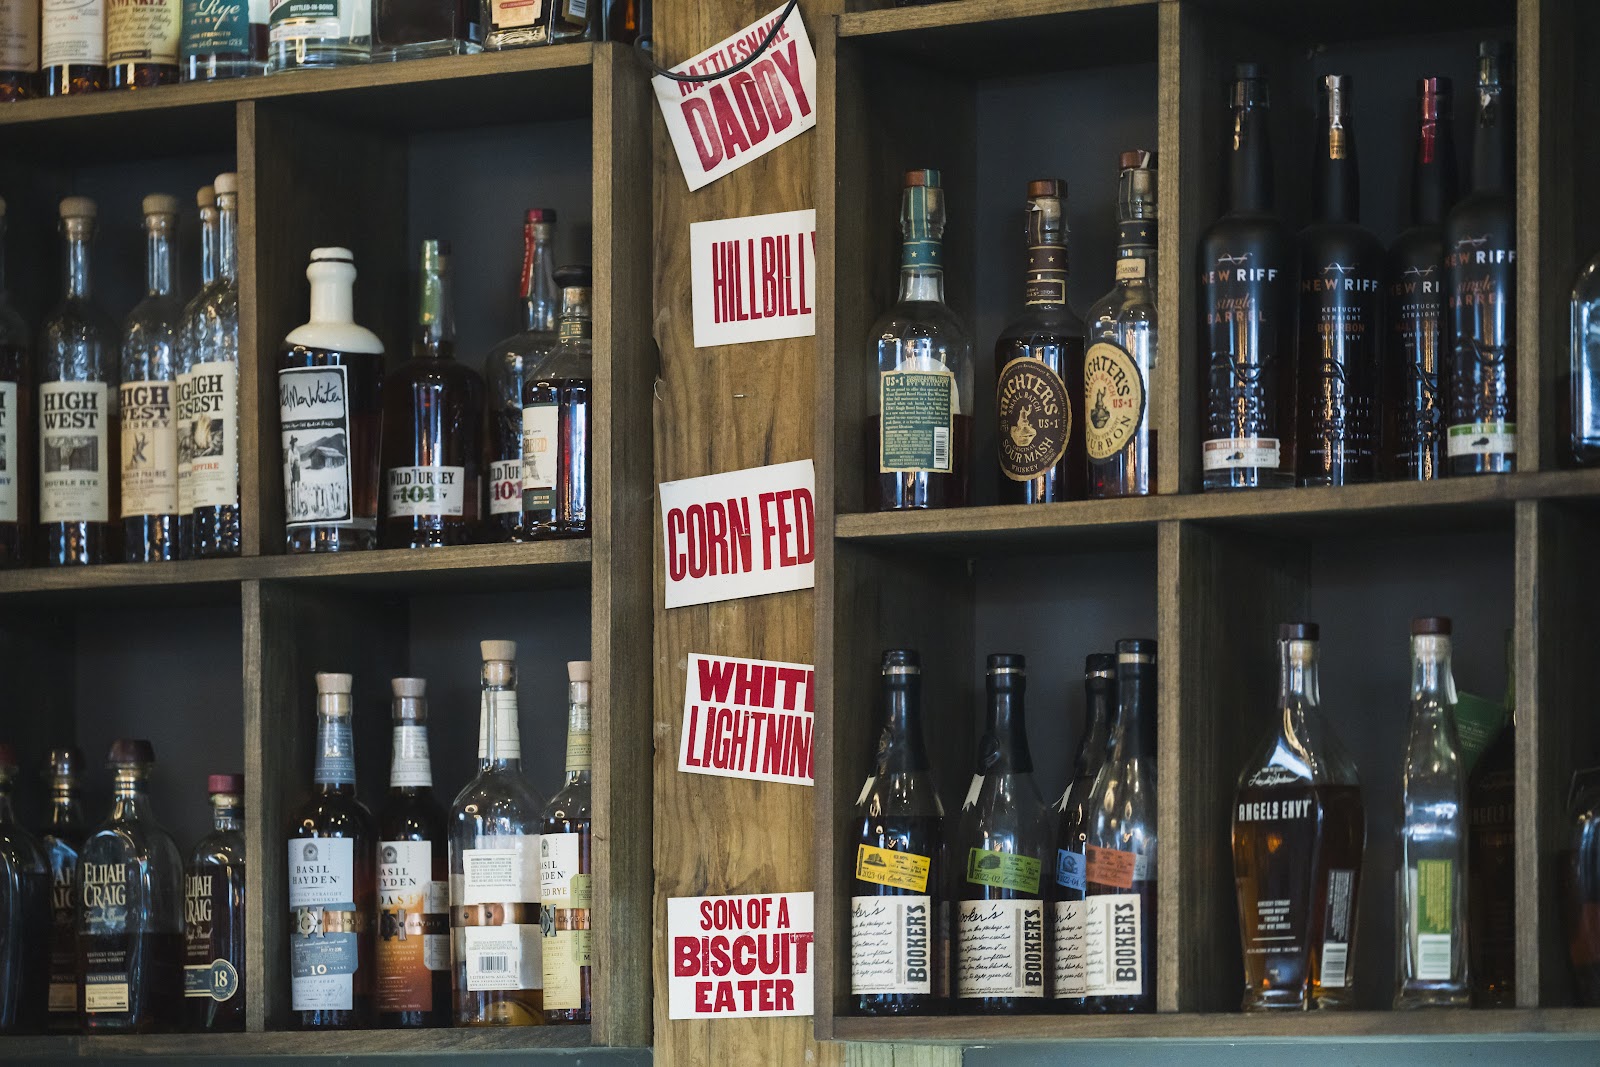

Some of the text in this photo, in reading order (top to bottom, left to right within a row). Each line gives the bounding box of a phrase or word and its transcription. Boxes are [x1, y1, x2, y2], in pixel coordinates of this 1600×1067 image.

[675, 13, 790, 97] RATTLESNAKE
[680, 39, 811, 172] DADDY
[1476, 249, 1516, 265] RIFF
[1236, 268, 1276, 282] RIFF
[1344, 278, 1377, 292] RIFF
[1422, 280, 1440, 293] RI
[1448, 292, 1507, 309] BARRE
[1317, 323, 1365, 333] BOURBON
[44, 391, 98, 411] HIGH
[193, 395, 223, 414] EST
[1008, 391, 1042, 414] SMALL BATCH
[44, 411, 98, 430] WEST
[1003, 437, 1054, 464] SOUR MASH
[390, 467, 455, 486] WILD TUREY
[1011, 464, 1038, 474] WHISKEY
[44, 480, 76, 488] DOUBLE
[400, 484, 436, 504] 101
[667, 487, 815, 582] CORN FED
[685, 705, 815, 780] LIGHTNIN
[1281, 799, 1309, 819] ENVY
[84, 862, 126, 886] ELIJAH
[296, 865, 330, 874] BASIL
[380, 867, 409, 876] ASIL
[541, 871, 564, 880] YDEN
[185, 874, 212, 899] ELIJAH
[292, 875, 339, 885] HAYDEN
[382, 878, 417, 887] YDEN
[83, 884, 126, 910] CRAIG
[552, 887, 567, 896] RYE
[185, 899, 212, 925] CRAIG
[700, 897, 790, 931] SON OF A
[906, 902, 928, 983] BOOKER'S
[1024, 906, 1043, 987] BOOKER'S
[1114, 903, 1138, 982] BOOKER'S
[674, 932, 814, 977] BISCUIT
[214, 970, 228, 988] 18
[310, 964, 328, 976] 10
[695, 979, 794, 1013] EATER
